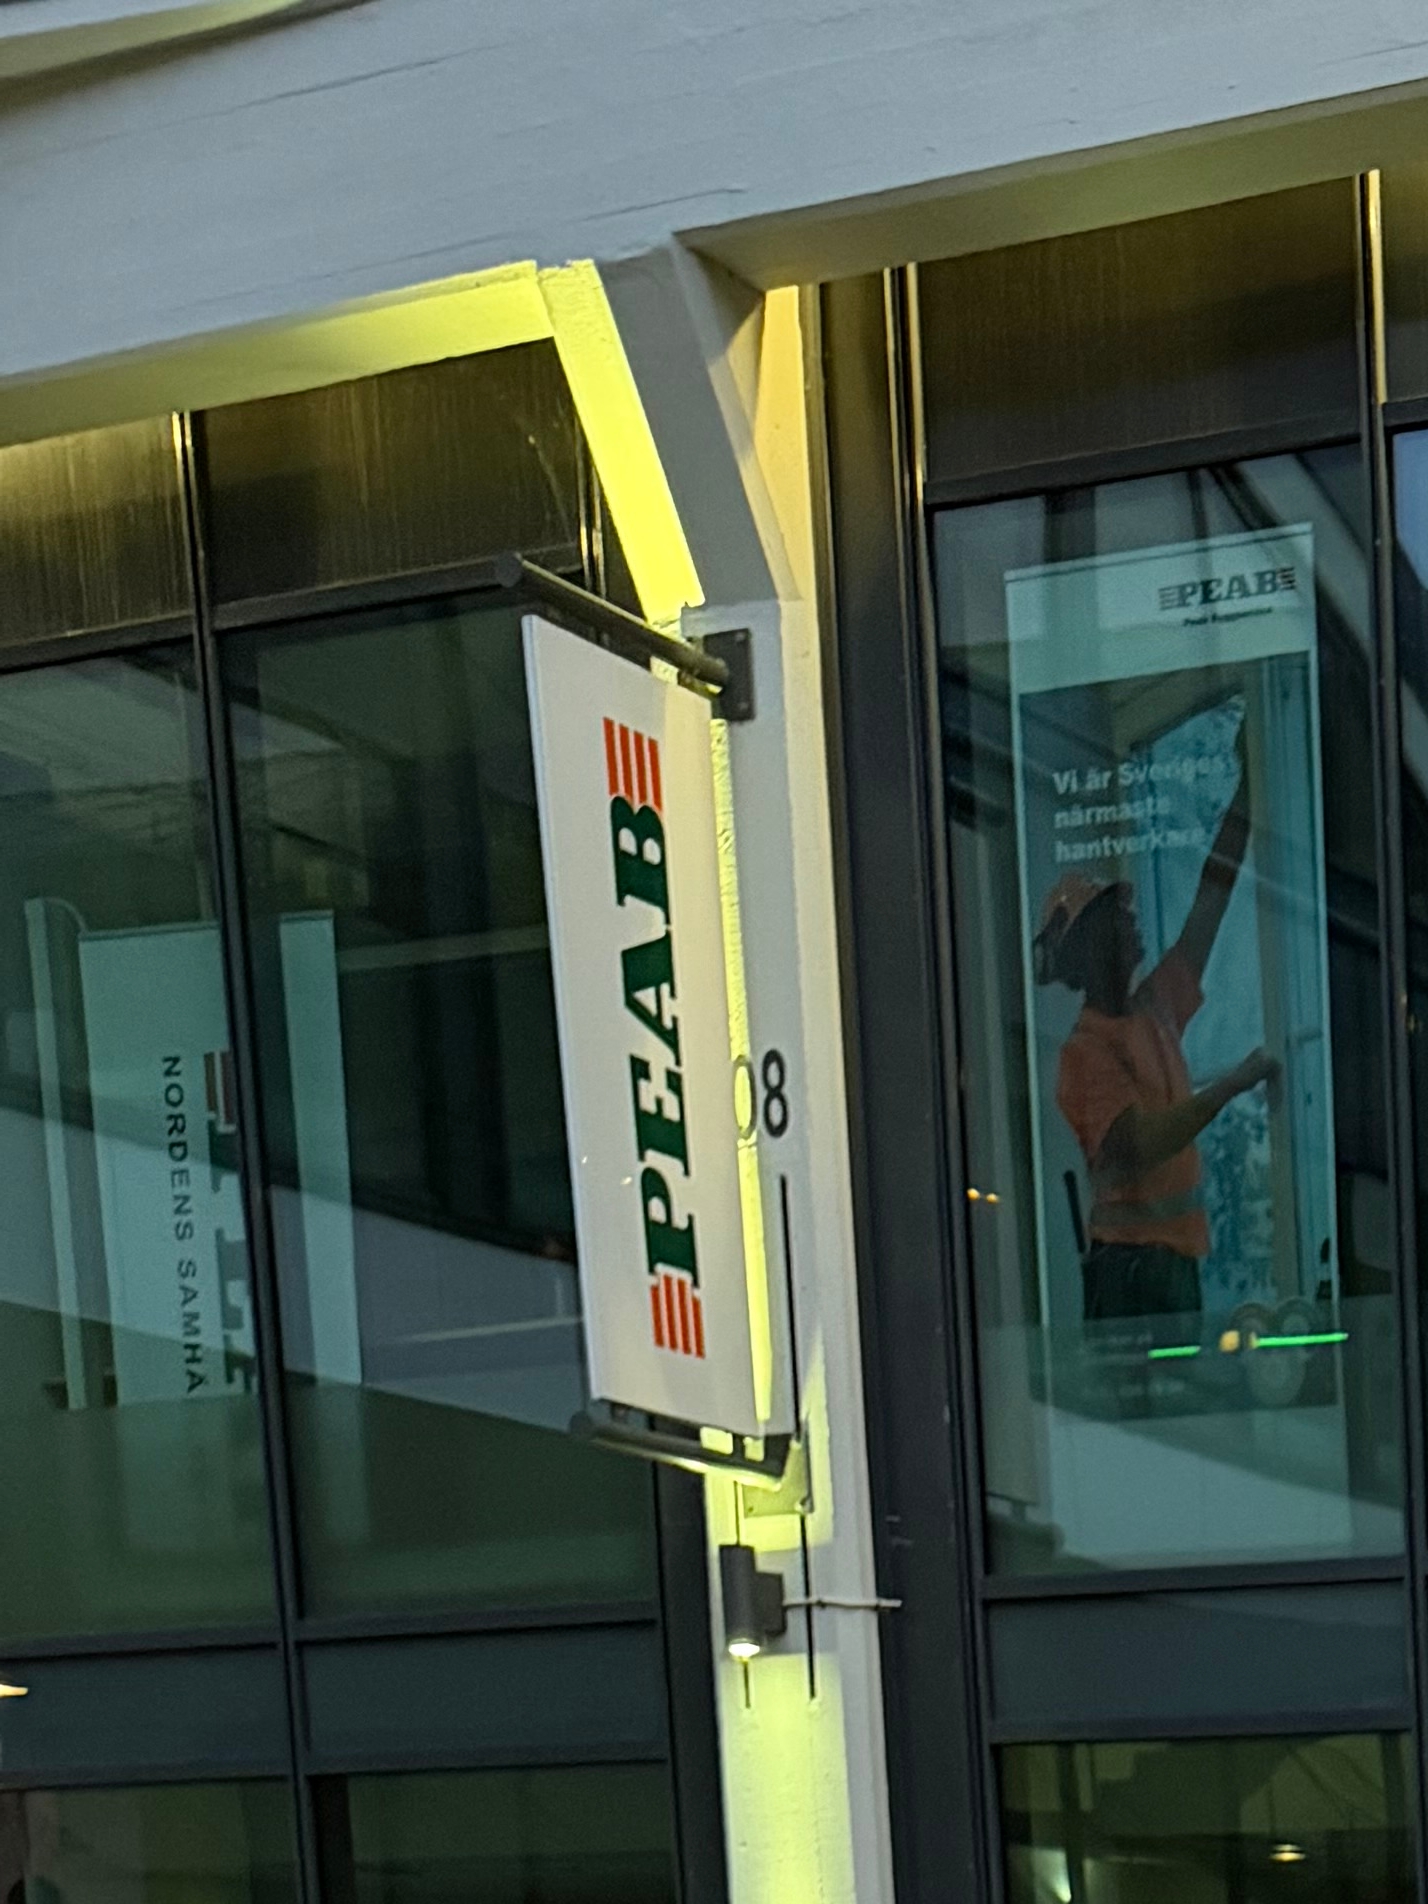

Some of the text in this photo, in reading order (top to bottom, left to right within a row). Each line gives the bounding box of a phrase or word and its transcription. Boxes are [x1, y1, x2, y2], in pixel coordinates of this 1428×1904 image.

[1177, 569, 1279, 607] PEAB
[1052, 755, 1230, 795] Vi är Sveriges
[1054, 796, 1171, 829] närmaste
[1054, 827, 1207, 863] hantverkare
[610, 794, 699, 1288] PEAB
[162, 1055, 195, 1243] NORDENS
